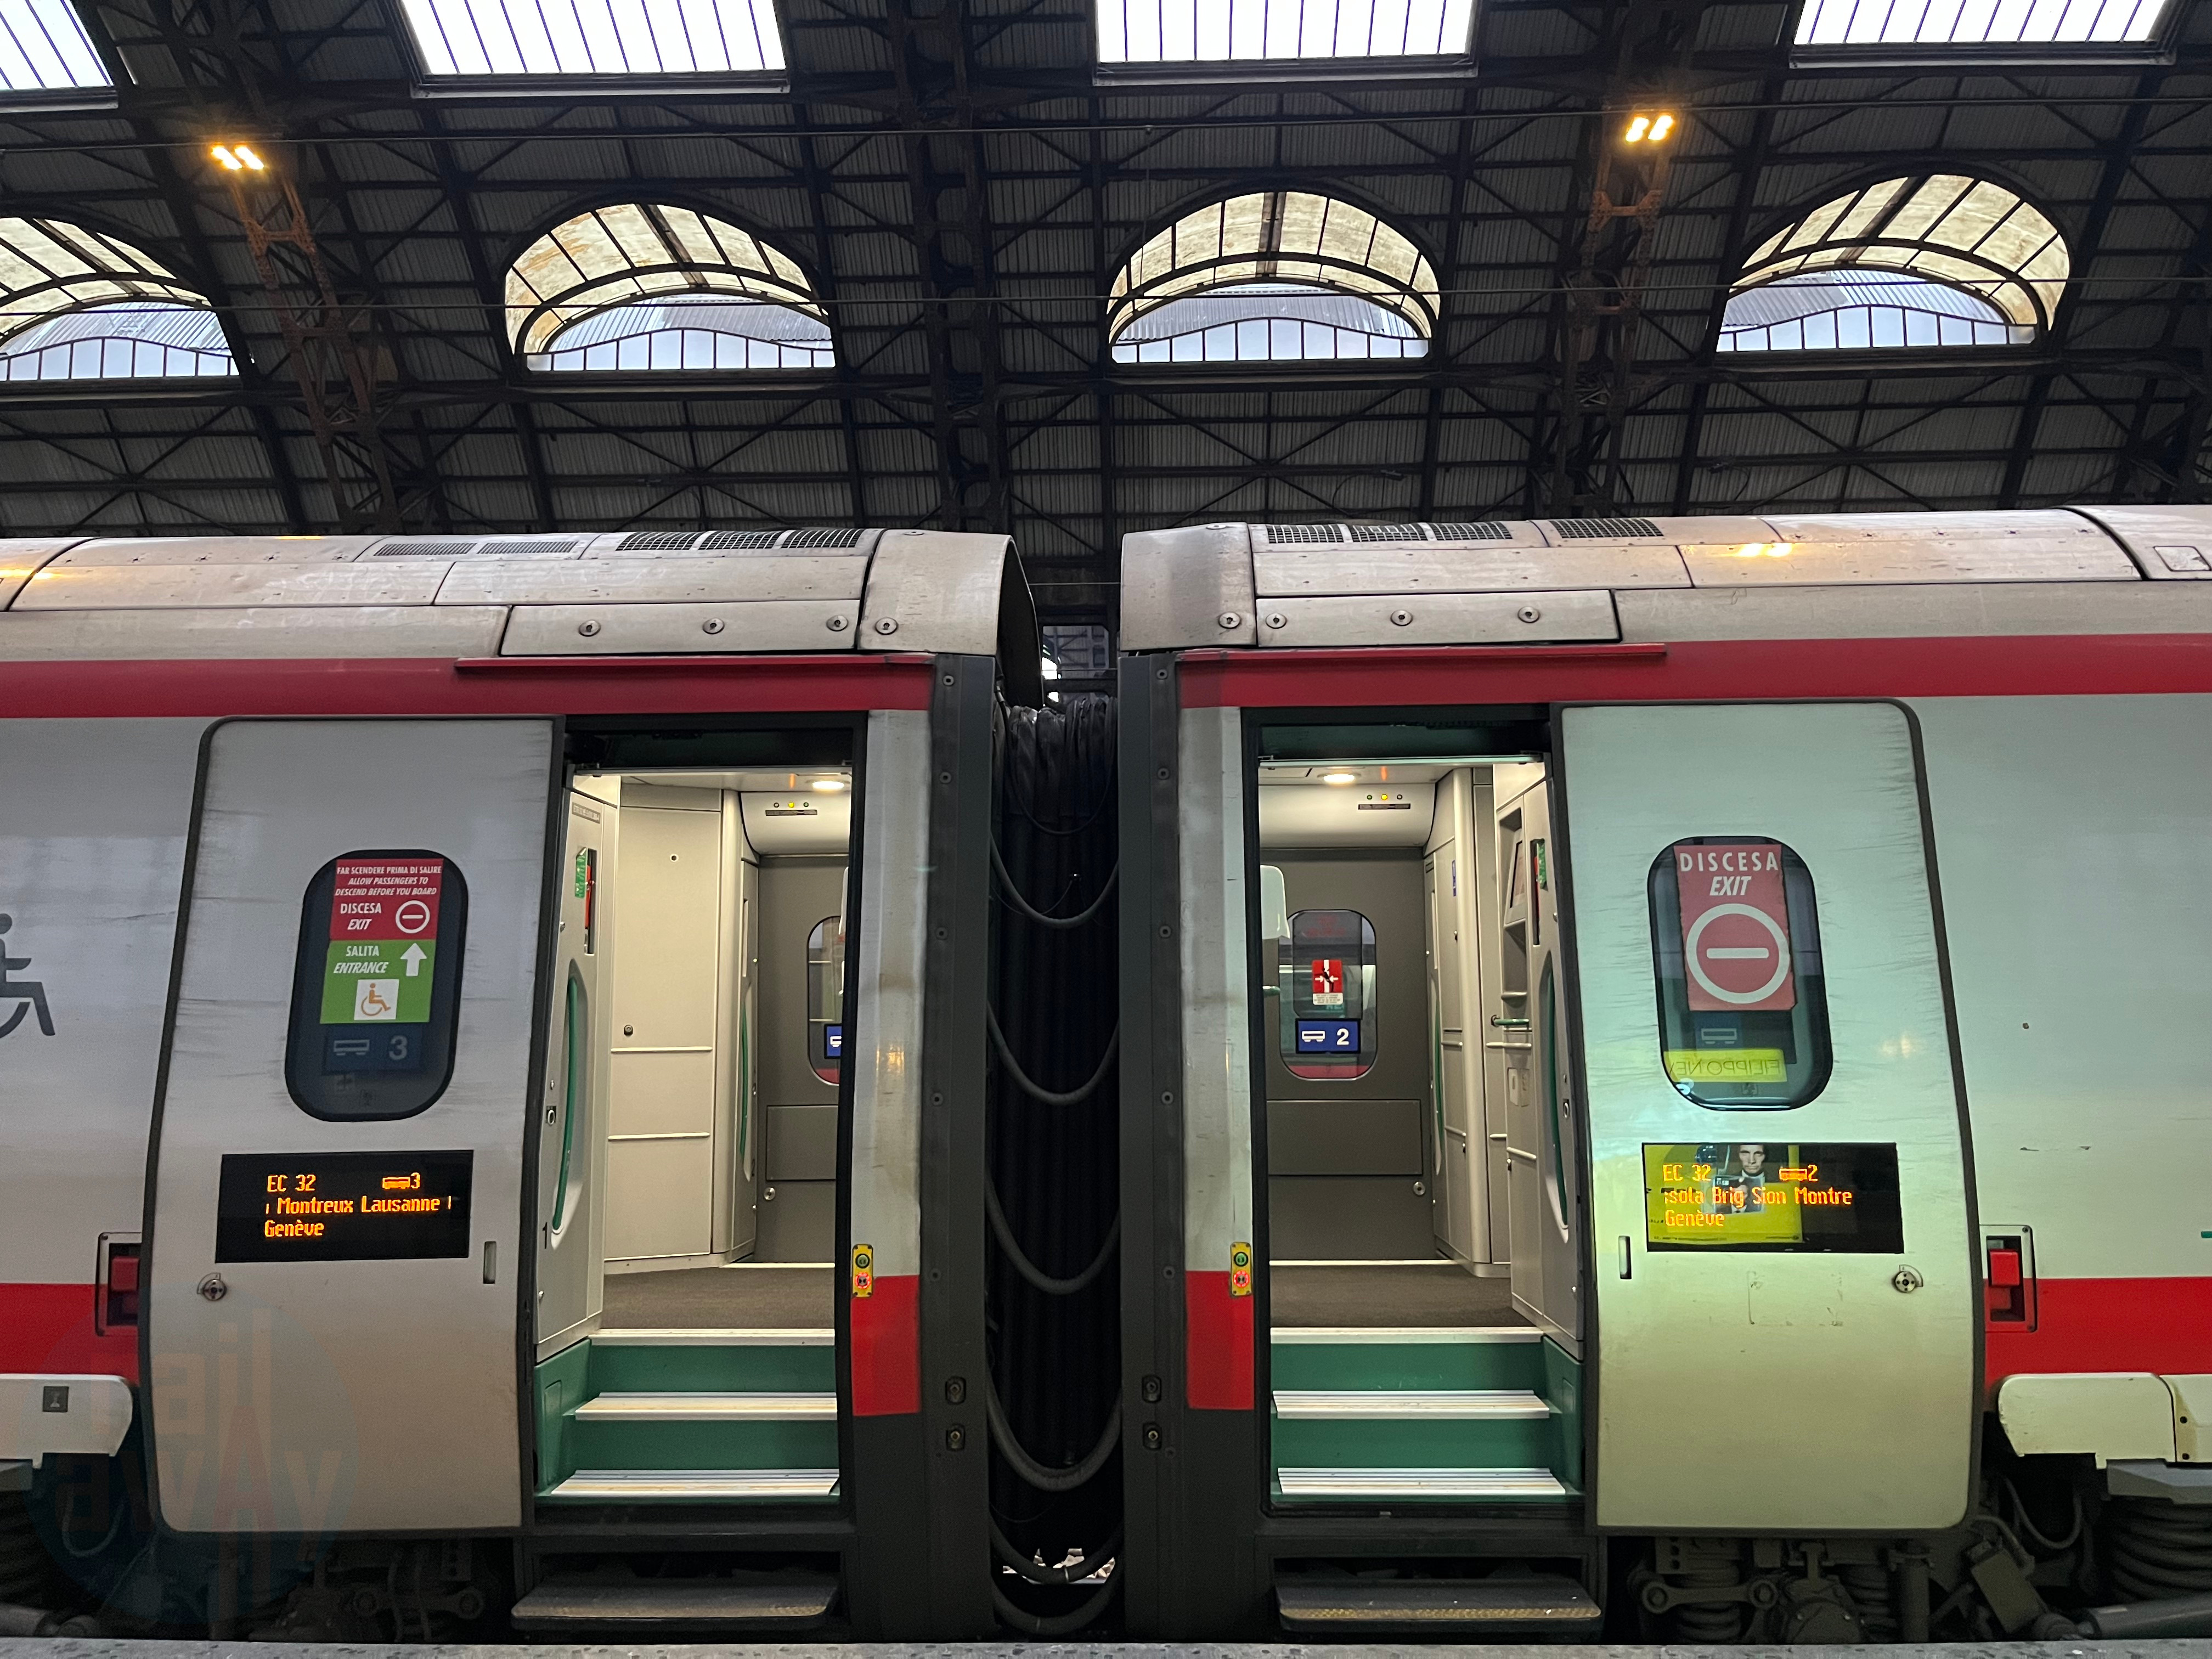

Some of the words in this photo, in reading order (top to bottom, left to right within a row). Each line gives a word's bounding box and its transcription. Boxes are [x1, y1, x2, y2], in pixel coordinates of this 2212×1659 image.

[1680, 851, 1779, 872] DISCESA
[373, 877, 418, 885] PASSENGERS
[1709, 876, 1752, 896] EXIT
[340, 902, 382, 914] DISCESA
[347, 918, 373, 930] EXIT
[346, 945, 380, 956] SALITA
[333, 962, 389, 974] ENTRANCE
[1336, 1028, 1350, 1046] 2
[388, 1035, 408, 1060] 3
[410, 1172, 421, 1189] 3
[1662, 1164, 1683, 1182] EC
[1691, 1164, 1712, 1182] 32
[1807, 1164, 1818, 1182] 2
[267, 1174, 288, 1192] EC
[295, 1173, 317, 1192] 32
[277, 1197, 354, 1215] Montreux
[361, 1195, 441, 1213] Lausanne
[1712, 1186, 1745, 1208] Brig
[1752, 1186, 1787, 1204] Sion
[1794, 1186, 1852, 1205] Montre
[1665, 1209, 1725, 1227] Genève
[264, 1219, 325, 1237] Genève
